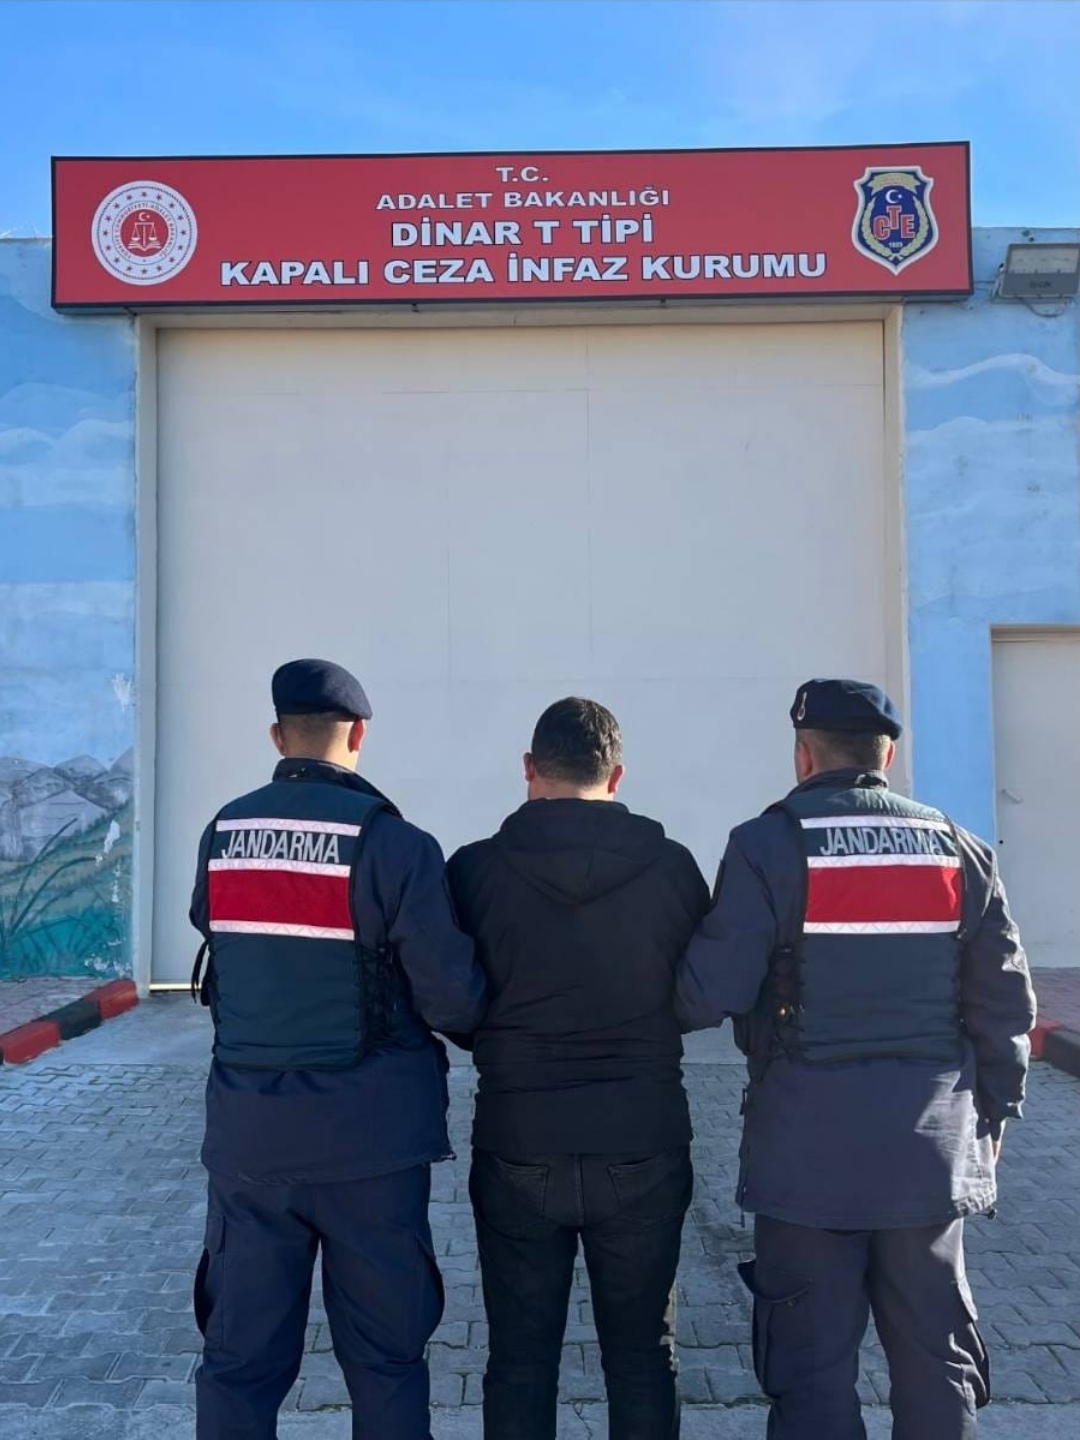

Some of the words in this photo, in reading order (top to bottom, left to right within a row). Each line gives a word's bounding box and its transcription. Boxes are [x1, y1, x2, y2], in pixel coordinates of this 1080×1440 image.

[496, 166, 548, 182] T.C.
[376, 193, 493, 210] ADALET
[504, 186, 669, 207] BAKANLIĞI
[392, 217, 521, 246] DİNAR
[534, 221, 560, 244] T
[572, 213, 652, 243] TİPİ
[222, 261, 368, 285] KAPALI
[384, 259, 494, 284] CEZA
[508, 253, 628, 282] İNFAZ
[642, 253, 825, 279] KURUMU
[221, 830, 340, 863] JANDARMA
[820, 826, 944, 856] JANDARMA
